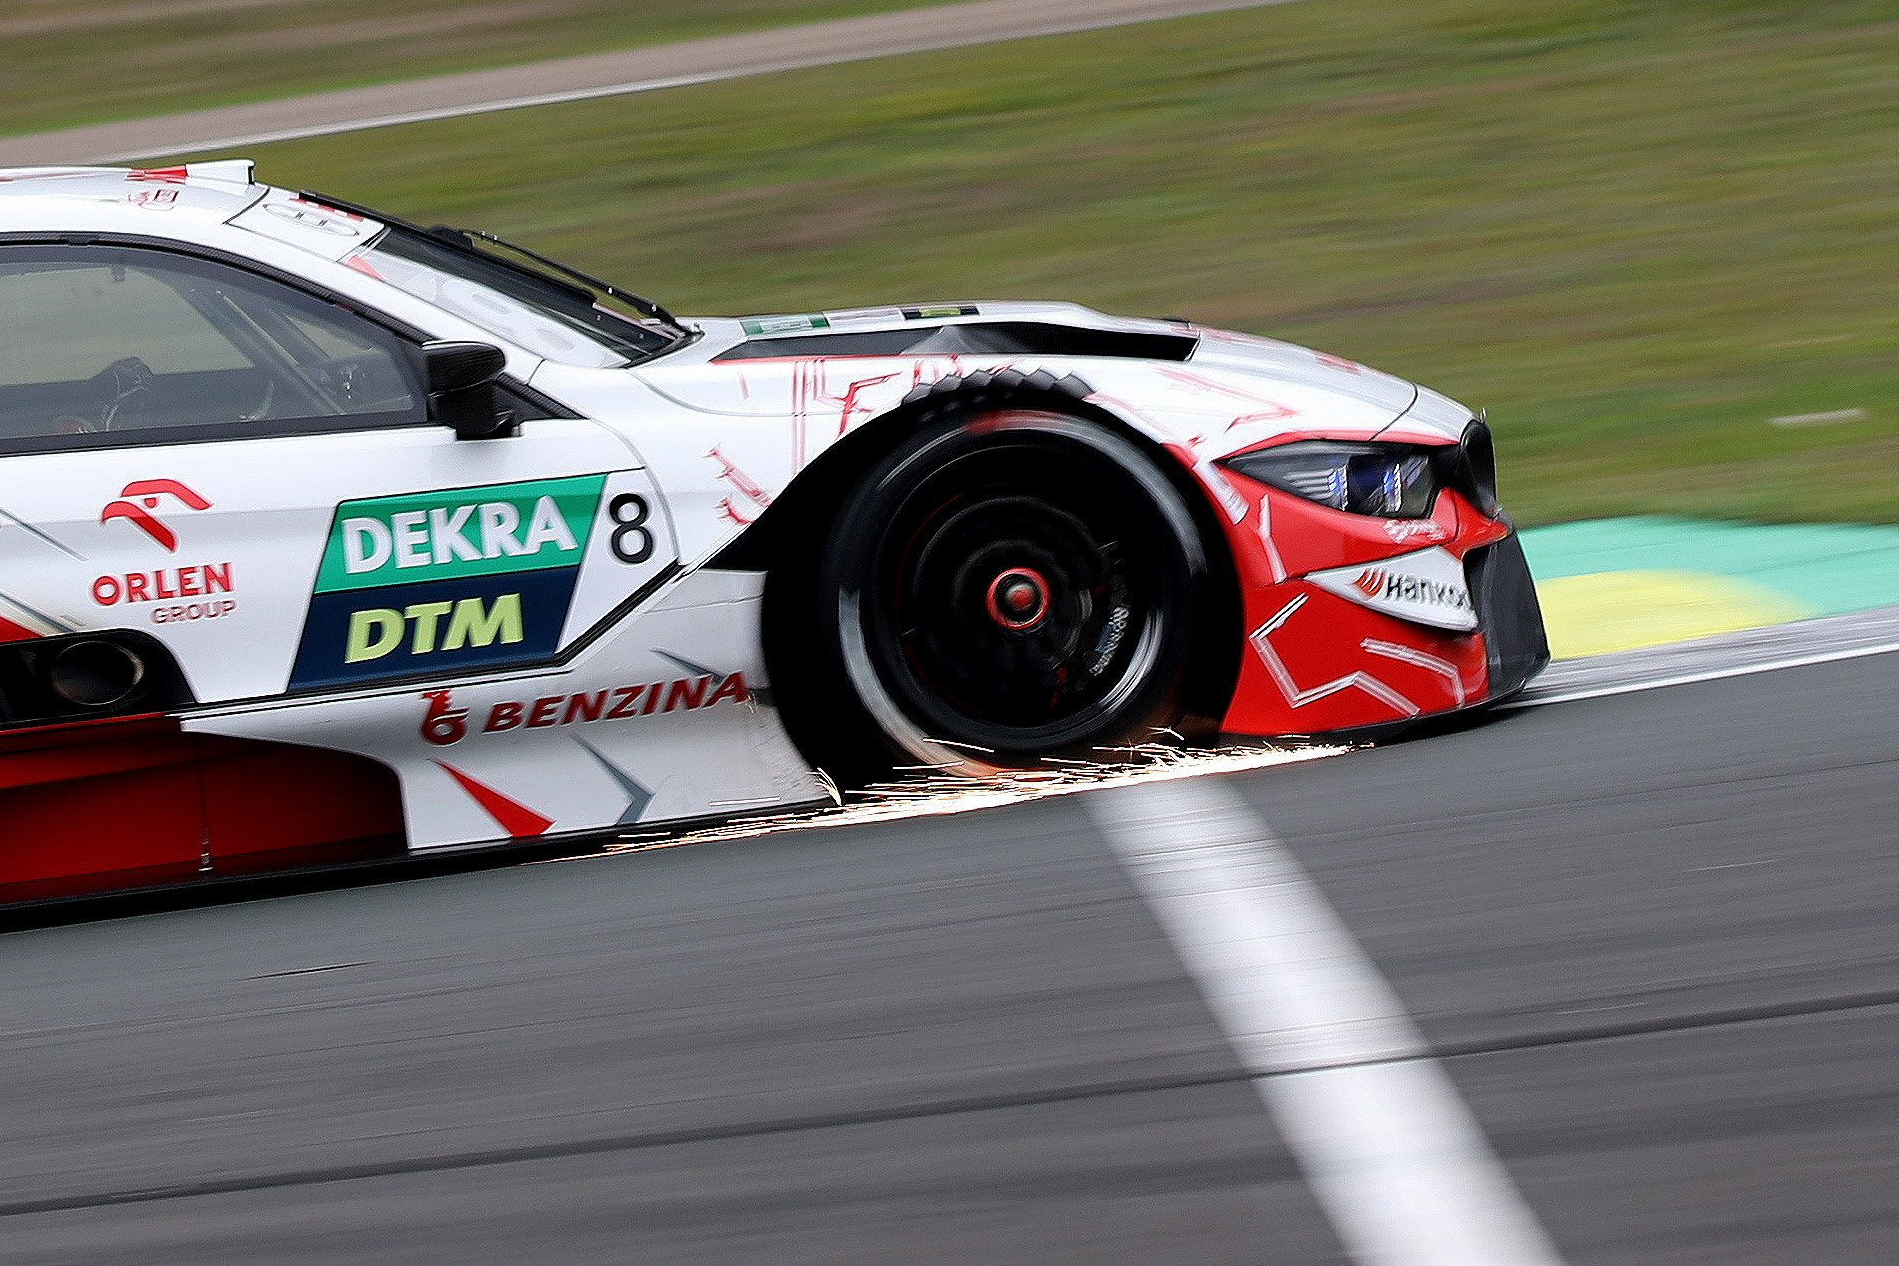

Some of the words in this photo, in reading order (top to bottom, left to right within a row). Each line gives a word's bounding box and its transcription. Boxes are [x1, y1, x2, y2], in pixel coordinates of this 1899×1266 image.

[340, 495, 580, 575] DEKRA
[609, 492, 654, 565] 8
[91, 562, 233, 607] ORLEN
[151, 599, 237, 624] GROUP
[344, 592, 525, 664] DTM
[481, 671, 750, 734] BENZINA
